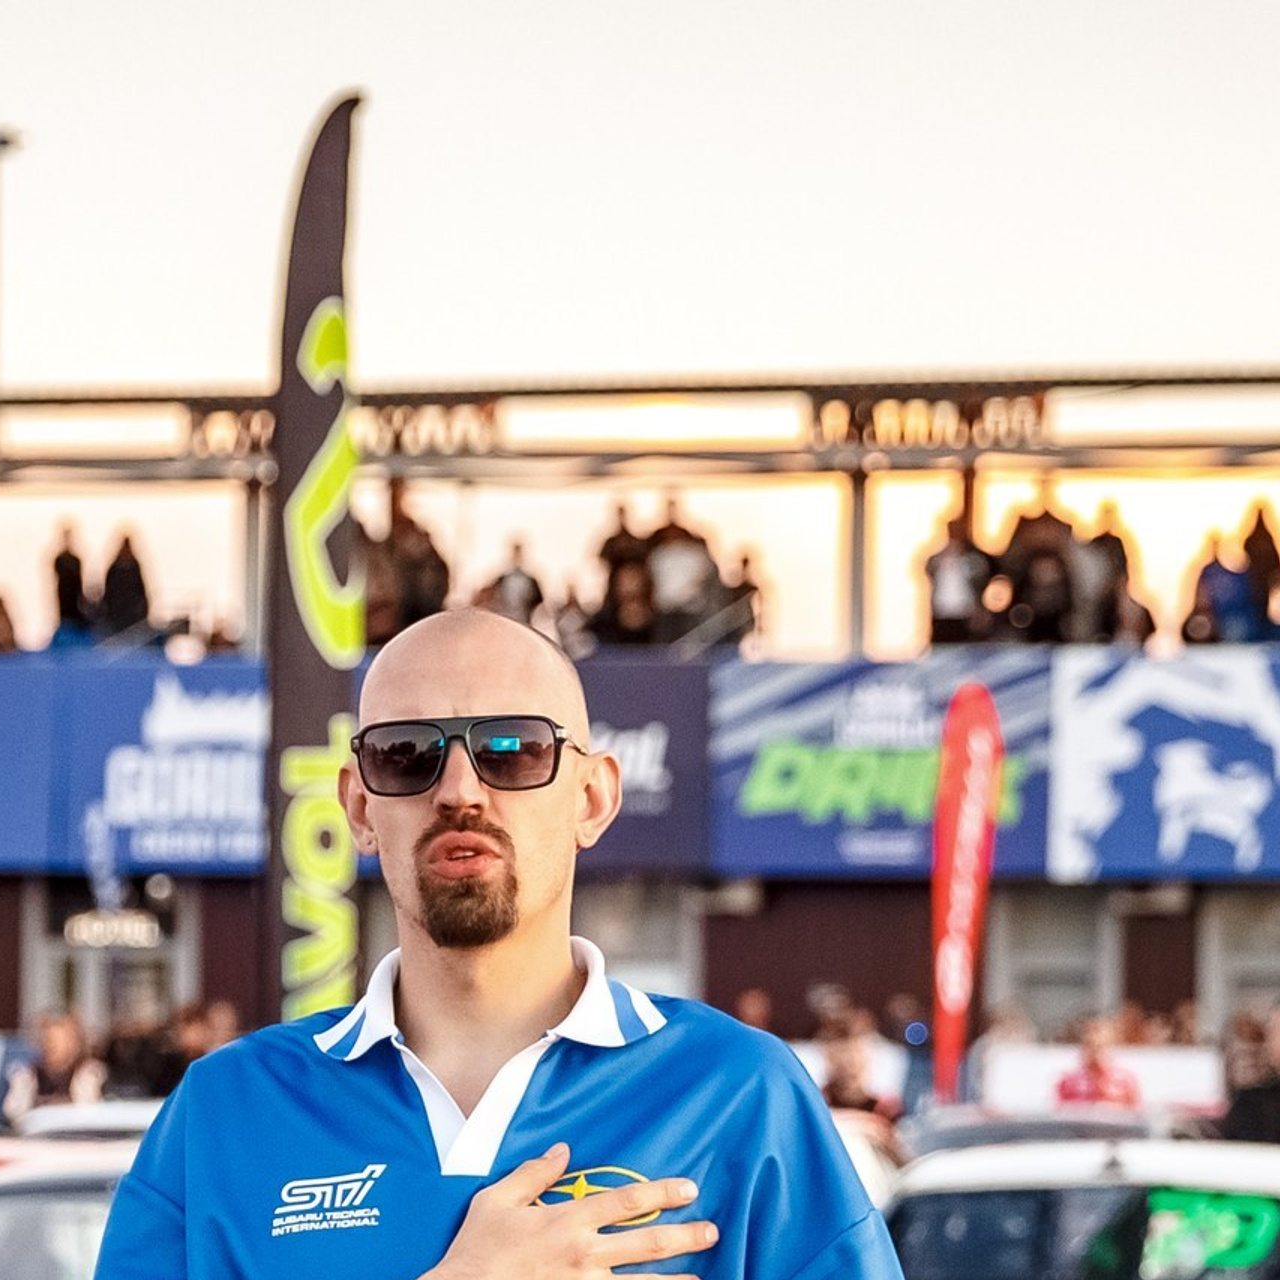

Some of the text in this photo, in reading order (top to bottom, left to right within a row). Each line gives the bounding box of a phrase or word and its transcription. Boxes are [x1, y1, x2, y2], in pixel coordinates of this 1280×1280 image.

[271, 1217, 379, 1237] INTERNATIONAL
[272, 1207, 380, 1228] SUBARU TECNICA
